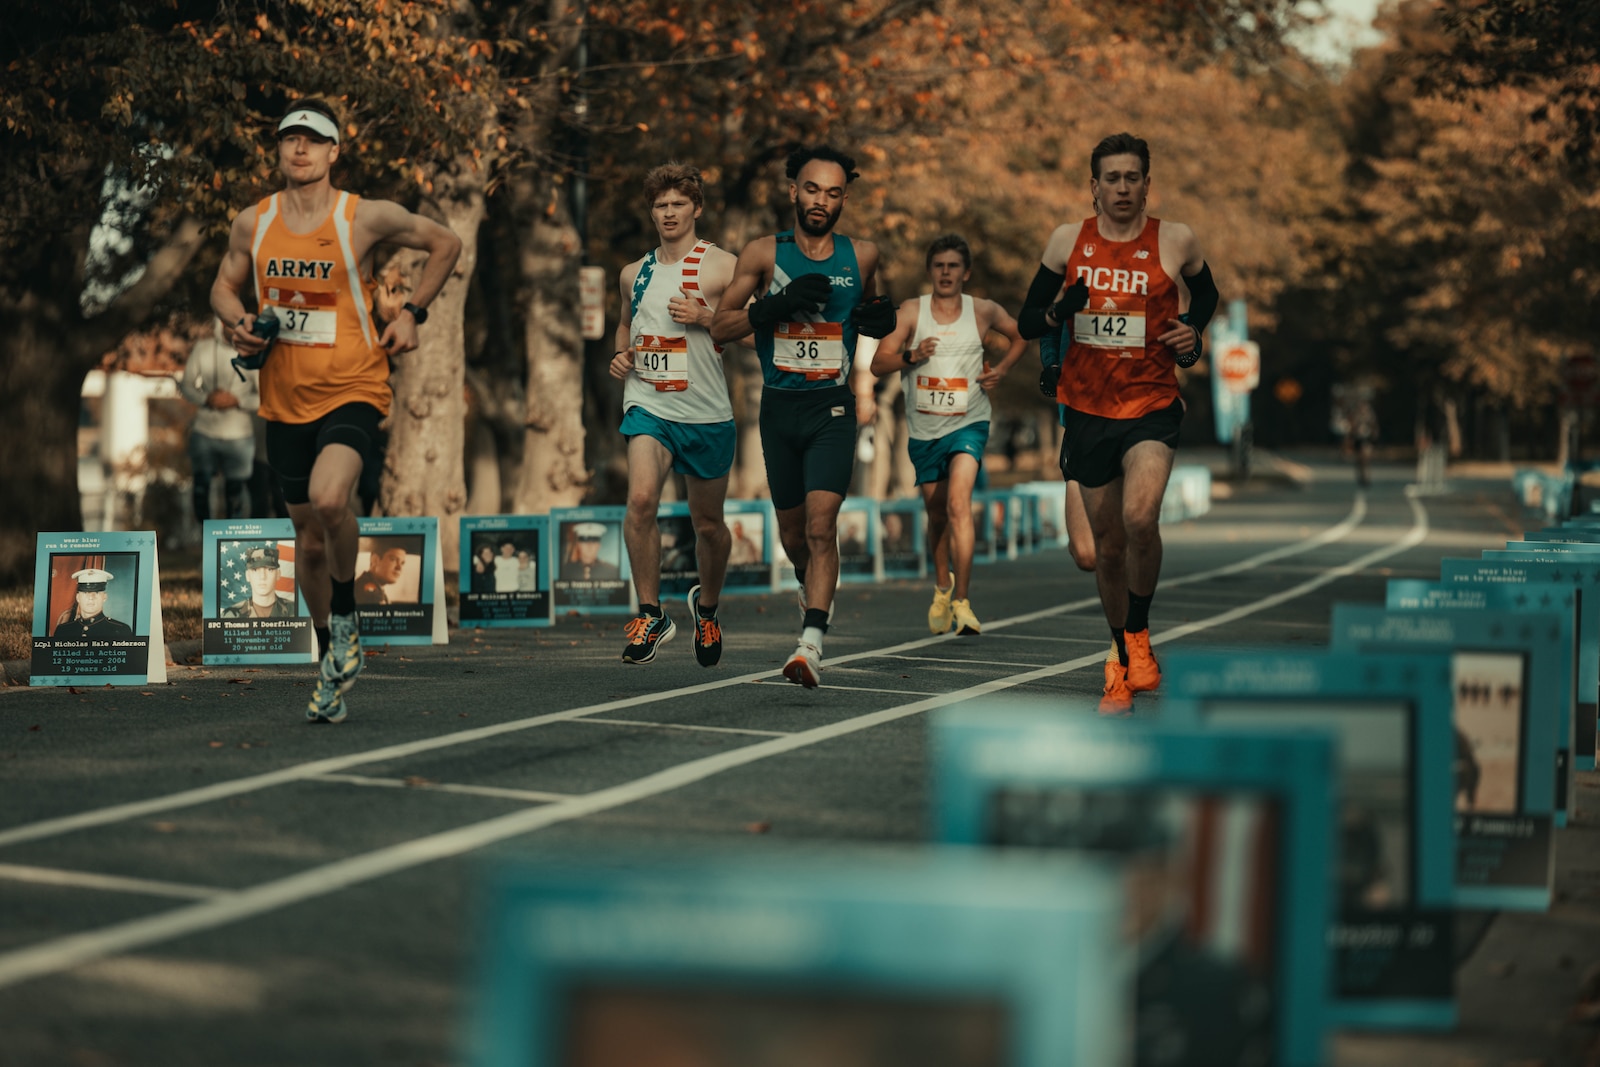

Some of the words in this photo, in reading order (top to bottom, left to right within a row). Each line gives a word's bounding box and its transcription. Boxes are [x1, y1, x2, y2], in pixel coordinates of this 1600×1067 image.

[266, 258, 335, 280] ARMY
[1077, 266, 1148, 296] DCRR
[286, 310, 309, 332] 37
[1092, 316, 1126, 336] 142
[796, 341, 818, 359] 36
[644, 353, 668, 370] 401
[930, 391, 955, 406] 175
